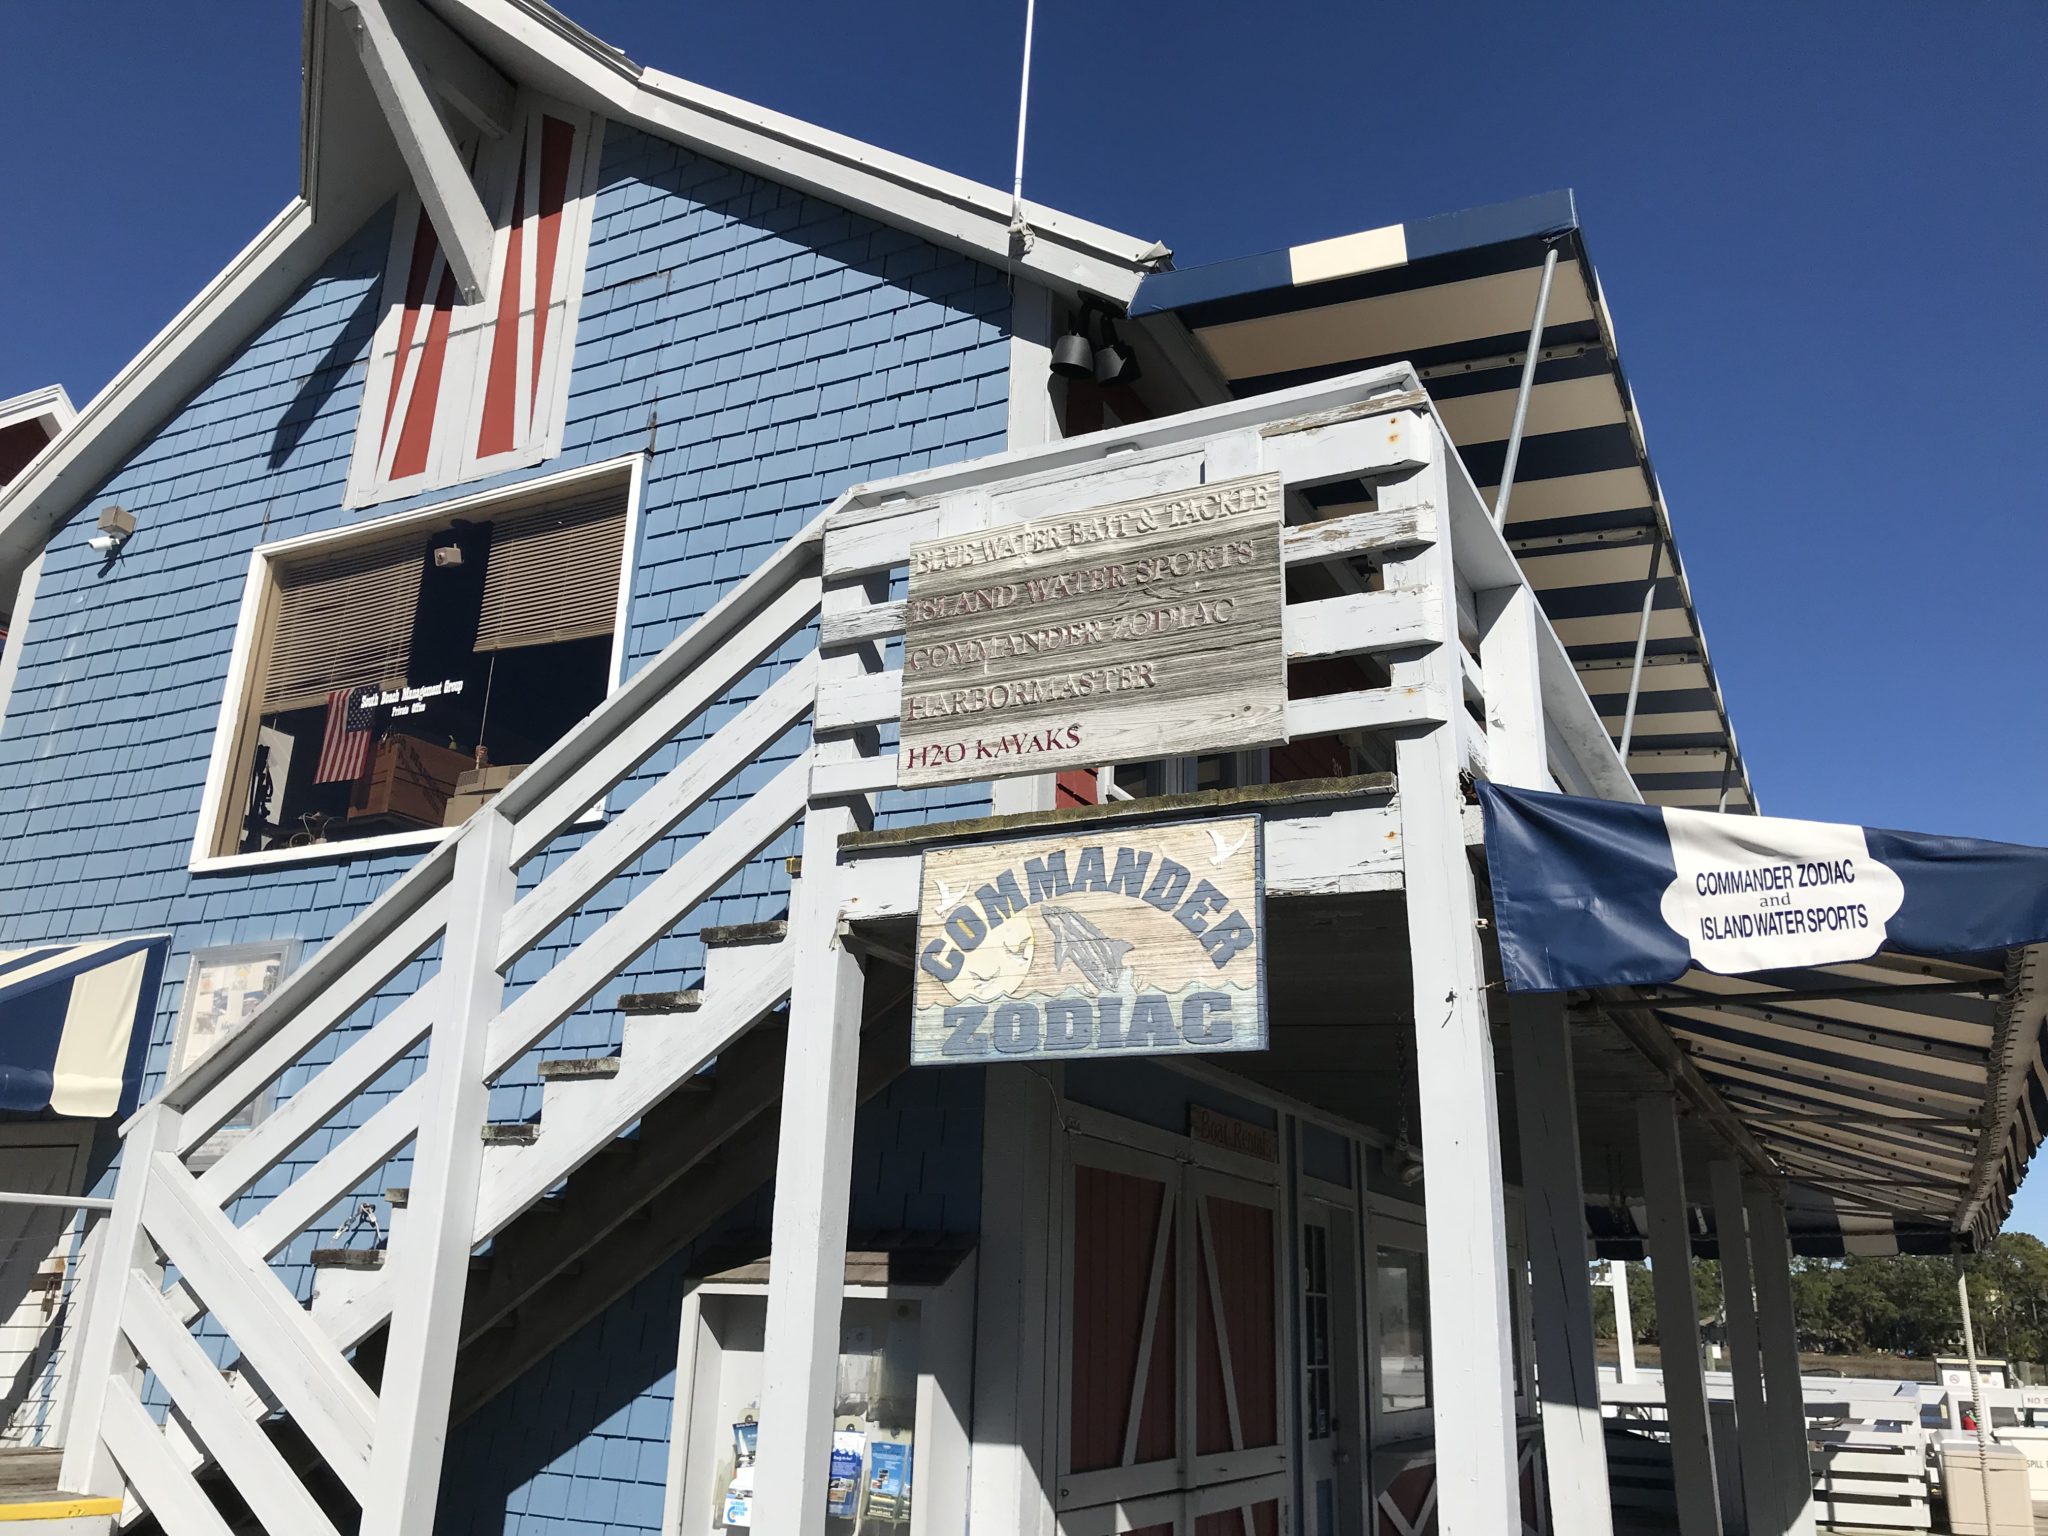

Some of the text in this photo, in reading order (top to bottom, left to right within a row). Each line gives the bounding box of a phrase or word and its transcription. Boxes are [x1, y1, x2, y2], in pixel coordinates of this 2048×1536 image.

[914, 484, 1271, 576] BLUE WATER BAIT & TACKLE
[912, 540, 1256, 622] ISLAND WATER SPORTS
[910, 598, 1236, 670] COMMANDER ZODIAC
[360, 680, 464, 708] South Beach Management Group
[907, 663, 1157, 721] HARBORMASTER
[907, 723, 1083, 769] H2O KAYAKS
[1696, 859, 1855, 896] COMMANDER ZODIAC
[1759, 892, 1791, 908] and
[920, 847, 1254, 983] COMMANDER
[942, 992, 1233, 1056] ZODIAC
